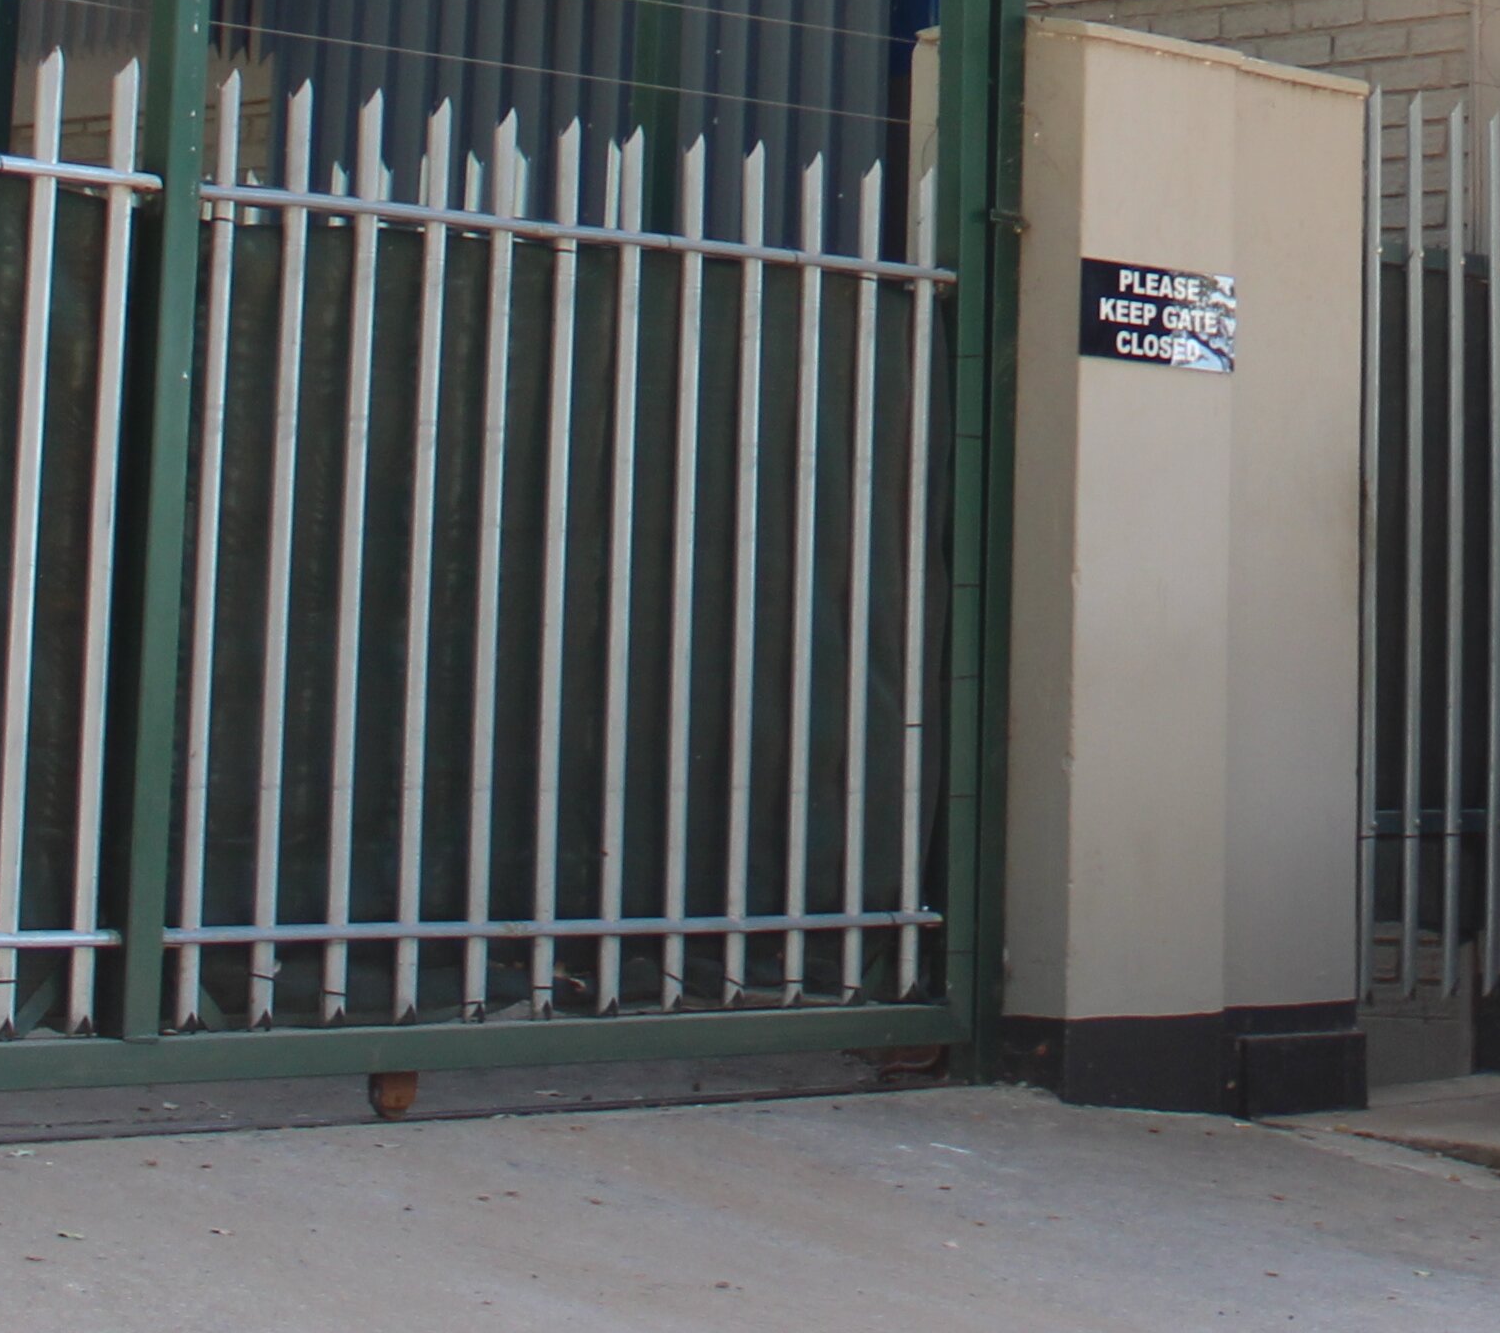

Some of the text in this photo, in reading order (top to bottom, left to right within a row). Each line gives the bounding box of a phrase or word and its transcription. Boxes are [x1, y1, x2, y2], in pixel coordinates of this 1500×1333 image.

[1118, 269, 1201, 302] PLEASE
[1099, 297, 1218, 334] KEEP GATE
[1116, 330, 1200, 362] CLOSED
